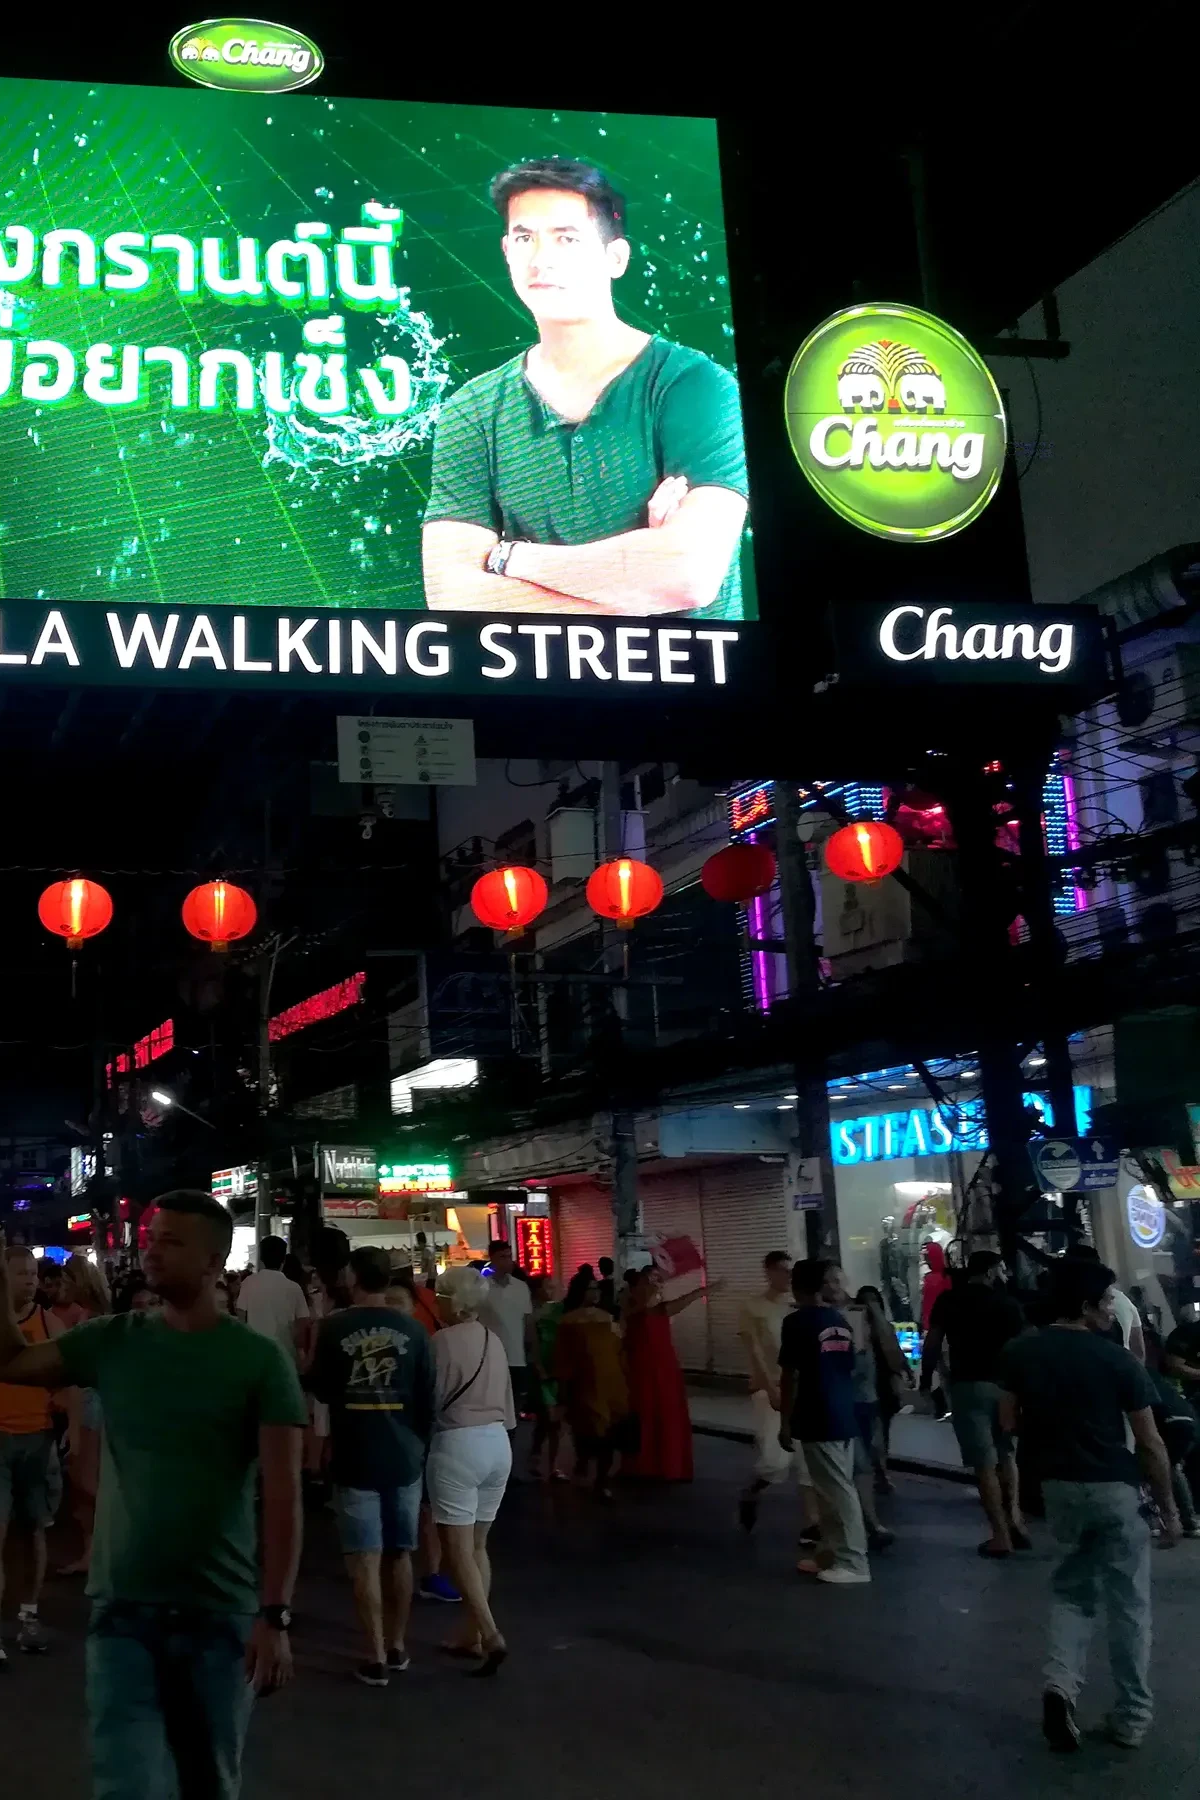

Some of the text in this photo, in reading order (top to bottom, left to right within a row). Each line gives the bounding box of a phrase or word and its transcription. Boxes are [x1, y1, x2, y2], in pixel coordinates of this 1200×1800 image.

[222, 38, 311, 73] Chang
[809, 415, 986, 479] Chang
[107, 612, 451, 677] WALKING
[480, 624, 738, 683] STREET
[880, 606, 1073, 672] Chang
